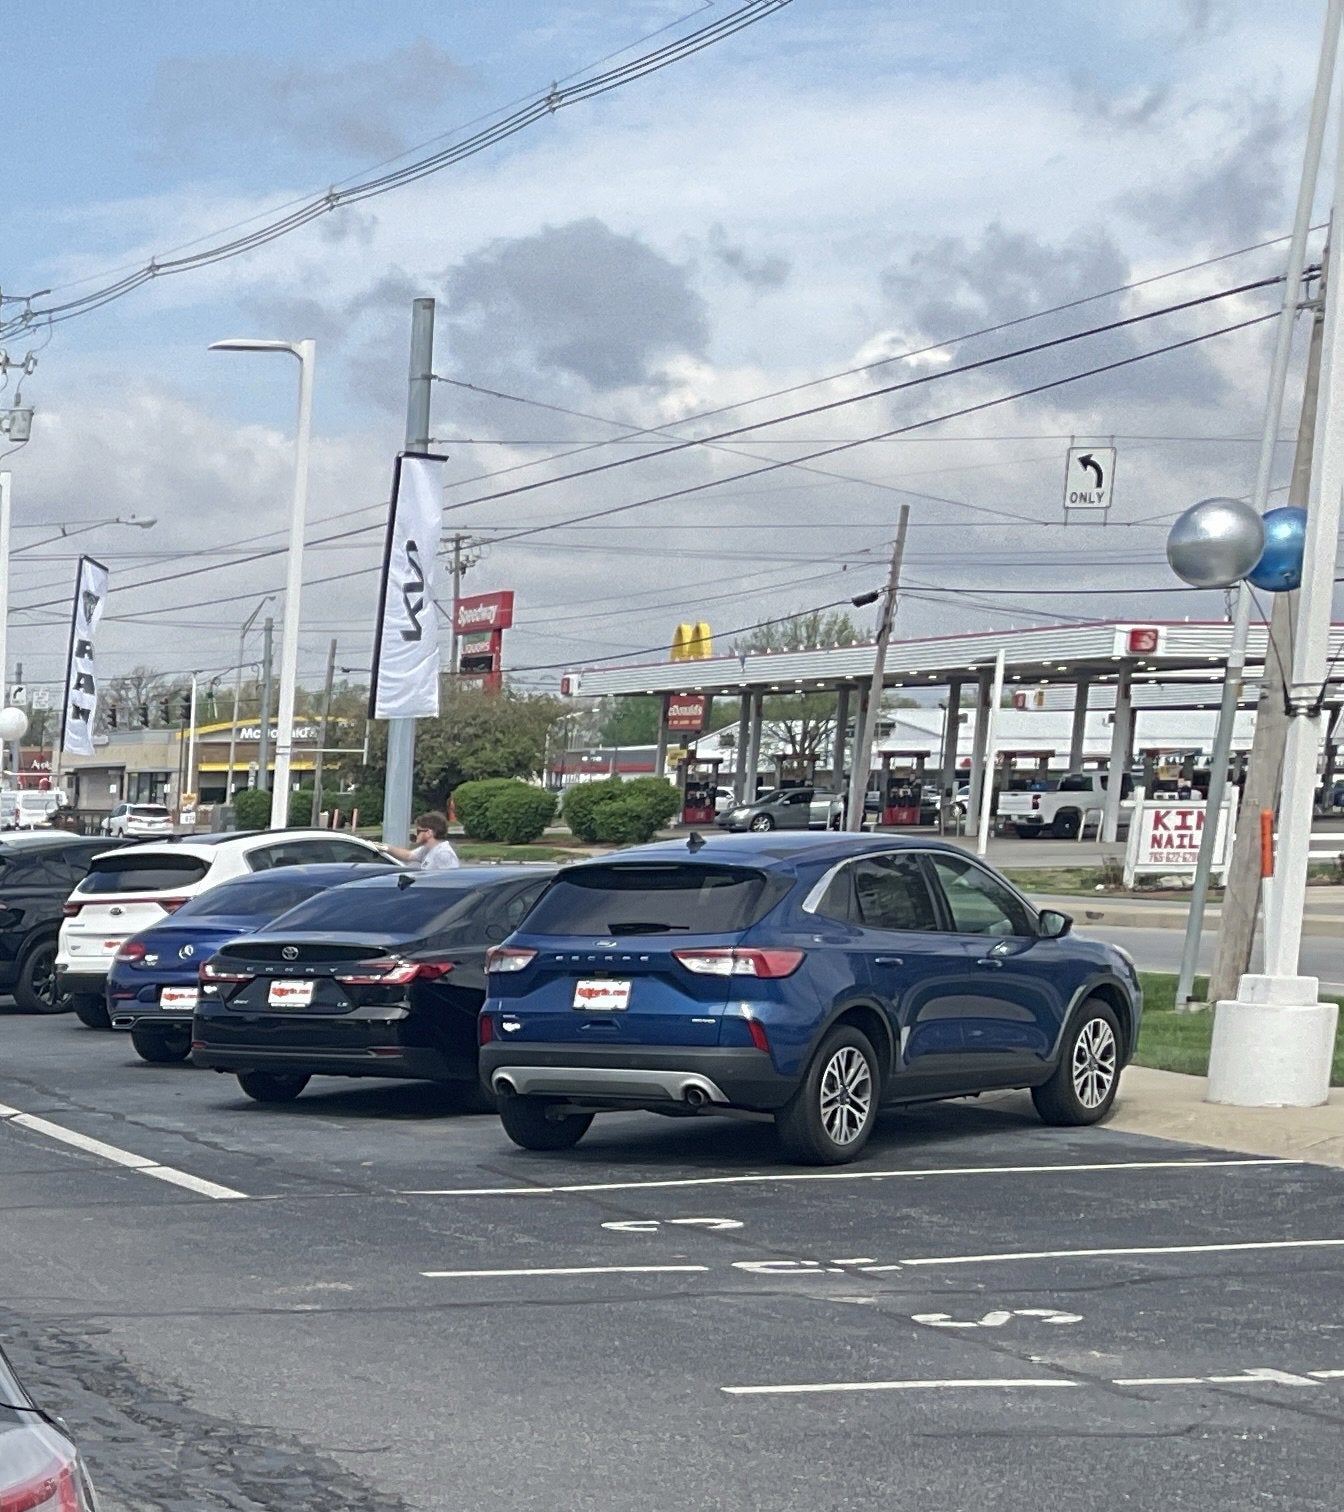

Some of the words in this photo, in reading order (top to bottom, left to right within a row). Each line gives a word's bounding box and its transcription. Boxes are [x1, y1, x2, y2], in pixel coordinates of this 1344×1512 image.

[1069, 491, 1104, 505] ONLY
[457, 603, 499, 627] Speedway
[1150, 833, 1201, 849] NAIL
